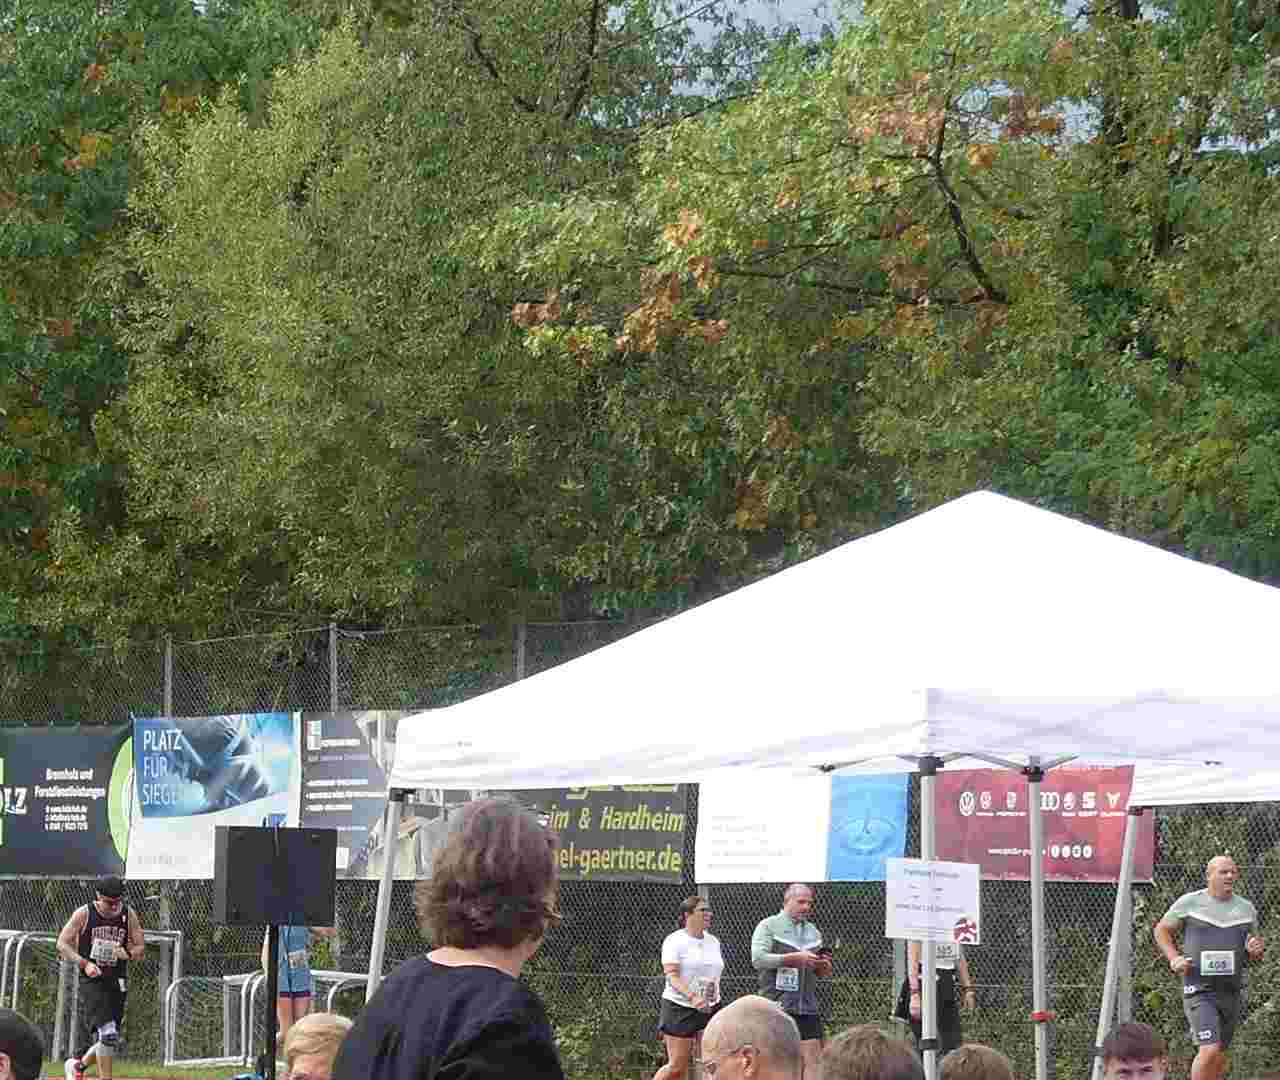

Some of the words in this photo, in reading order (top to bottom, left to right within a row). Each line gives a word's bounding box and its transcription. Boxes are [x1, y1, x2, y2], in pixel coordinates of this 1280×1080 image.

[143, 729, 182, 750] PLATZ
[142, 784, 177, 805] SIEGE
[578, 807, 591, 830] &
[599, 804, 685, 831] Hardheim
